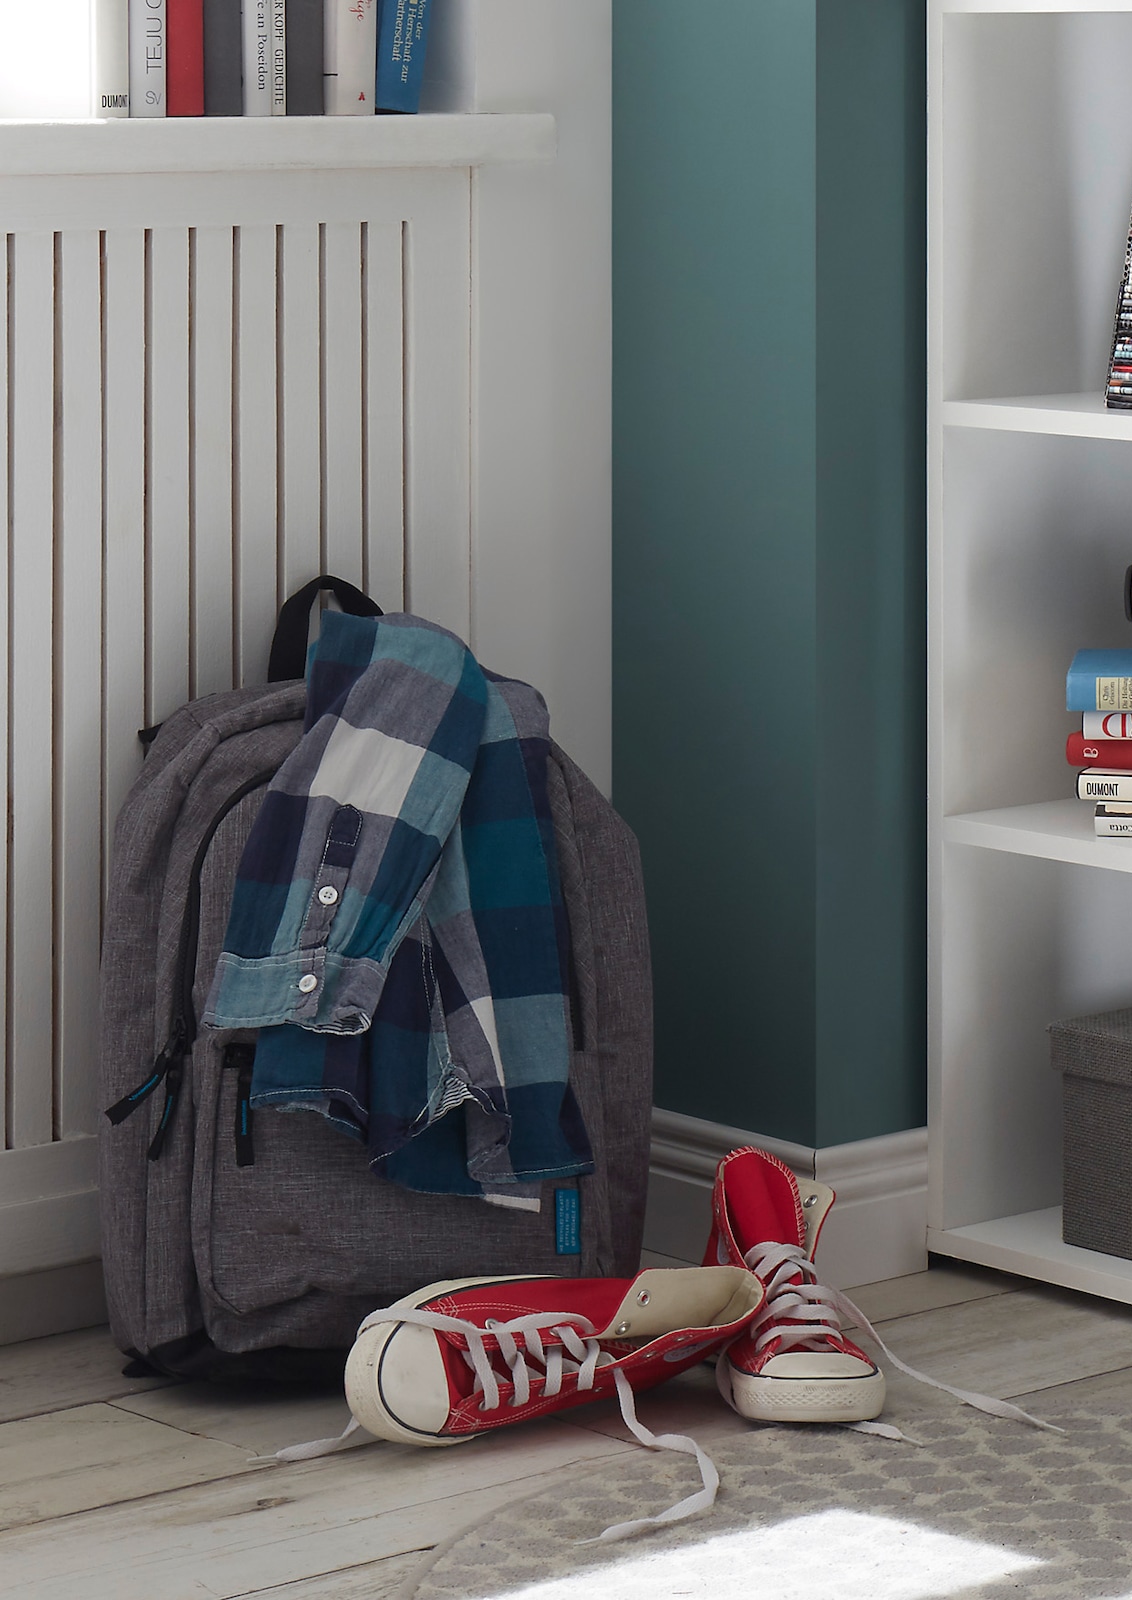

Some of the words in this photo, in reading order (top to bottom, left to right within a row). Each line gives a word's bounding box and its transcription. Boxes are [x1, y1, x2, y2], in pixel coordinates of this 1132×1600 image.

[257, 13, 265, 29] an
[417, 0, 426, 19] Von
[274, 13, 284, 41] KOPF
[403, 7, 417, 63] Herrschaft
[146, 17, 162, 75] TEJU
[257, 34, 268, 90] Poseidon
[401, 64, 409, 84] zur
[274, 48, 284, 106] GEDICHTE
[101, 94, 128, 109] DUMONT
[1086, 782, 1119, 797] DUMONT
